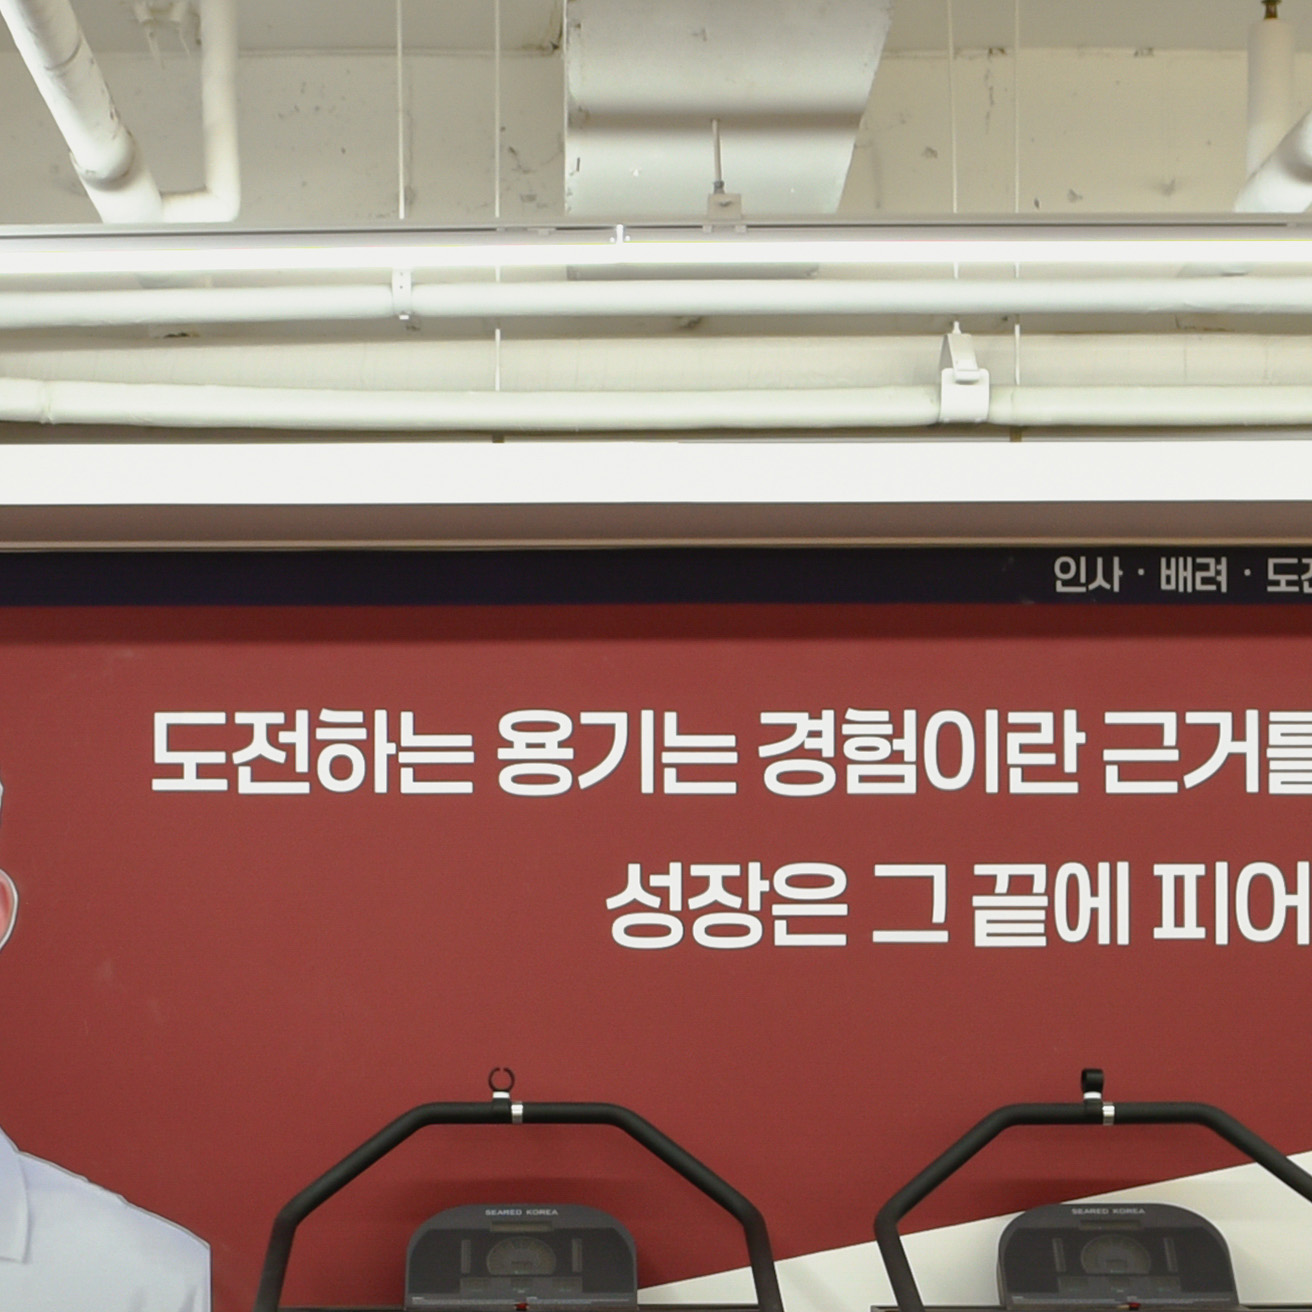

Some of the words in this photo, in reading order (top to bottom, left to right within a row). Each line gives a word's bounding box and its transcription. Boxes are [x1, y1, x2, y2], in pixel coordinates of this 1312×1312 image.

[1054, 556, 1124, 593] 인사
[1160, 556, 1228, 593] 배려
[151, 708, 475, 795] 도전하는
[497, 709, 739, 797] 용기는
[758, 707, 1087, 797] 경험이란
[605, 861, 849, 950] 성장은
[872, 864, 949, 943] 그
[971, 861, 1130, 948] 끝에
[525, 1207, 558, 1217] KOREA
[1112, 1206, 1146, 1216] KOREA
